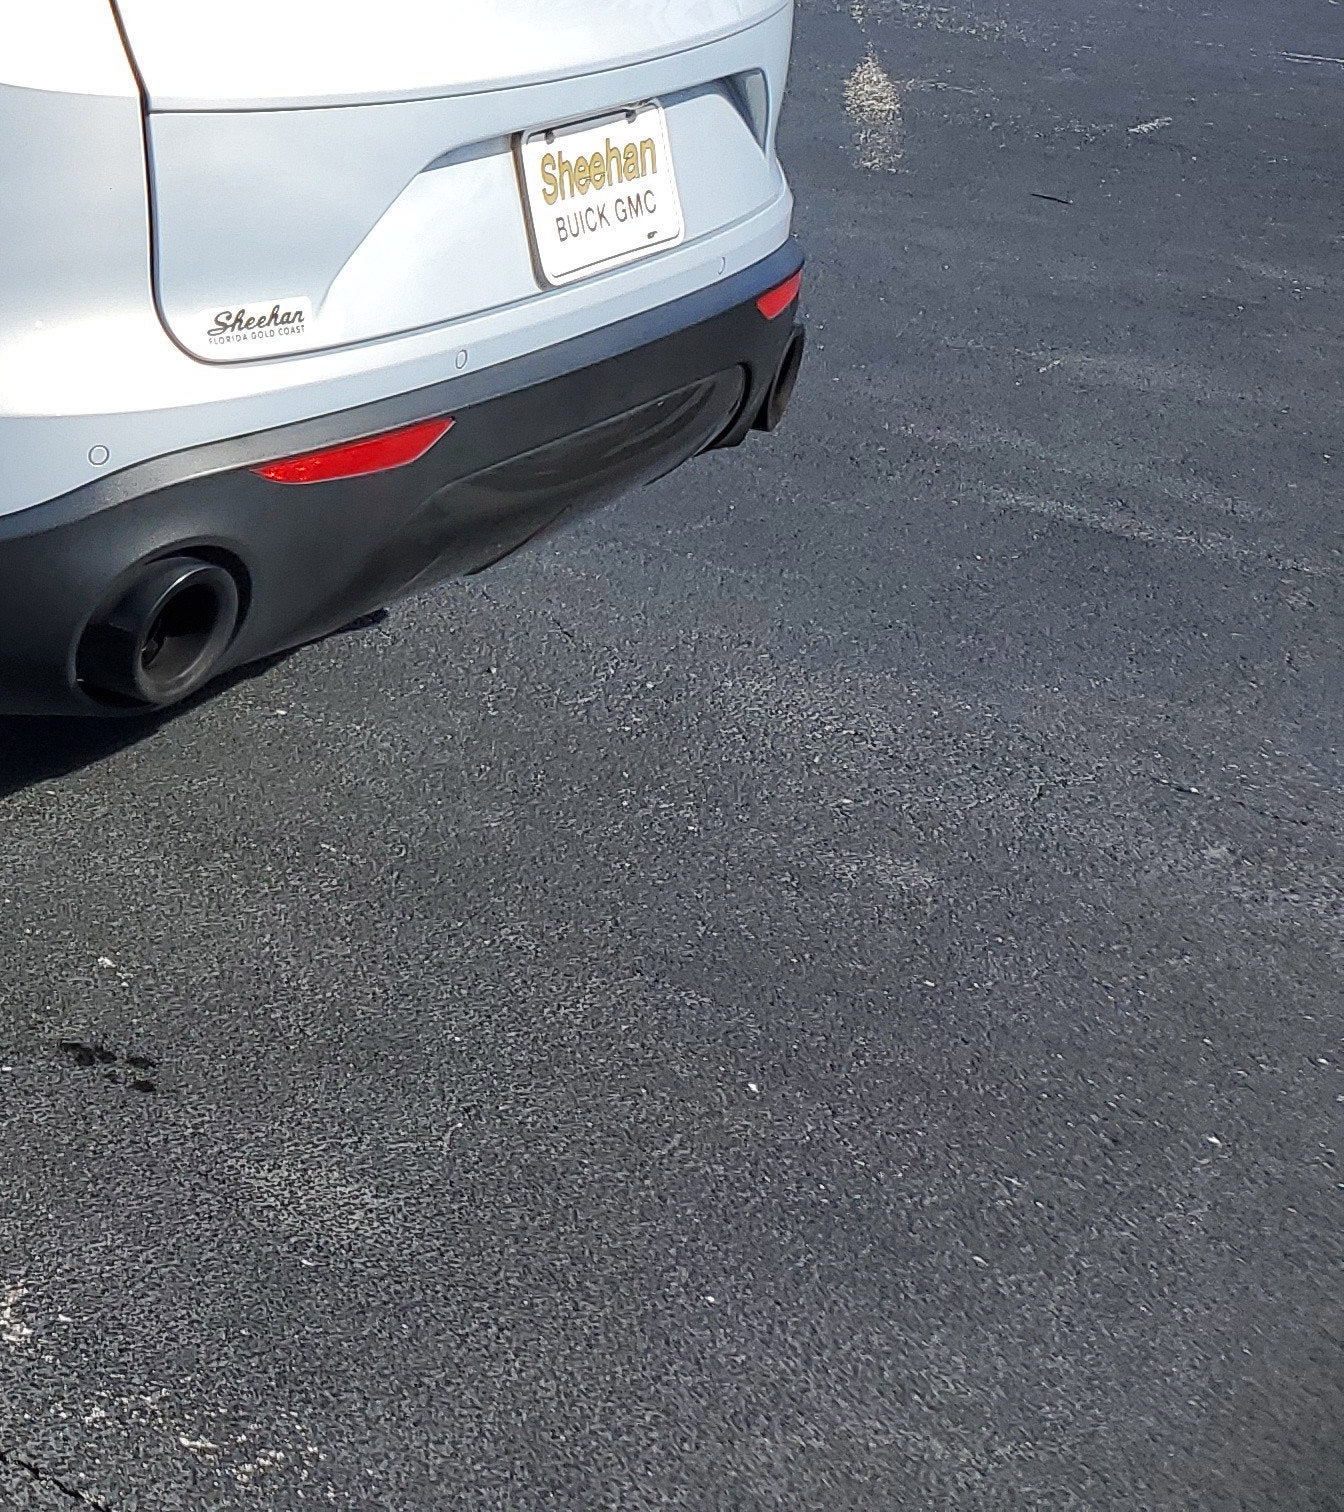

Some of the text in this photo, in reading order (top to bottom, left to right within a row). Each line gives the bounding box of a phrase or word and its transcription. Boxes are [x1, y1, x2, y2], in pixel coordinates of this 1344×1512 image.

[540, 138, 658, 205] Sheehan
[555, 189, 657, 242] BUICK GMC
[206, 304, 305, 336] Sheehan
[208, 324, 305, 345] FLORIDA GOLD COAST
